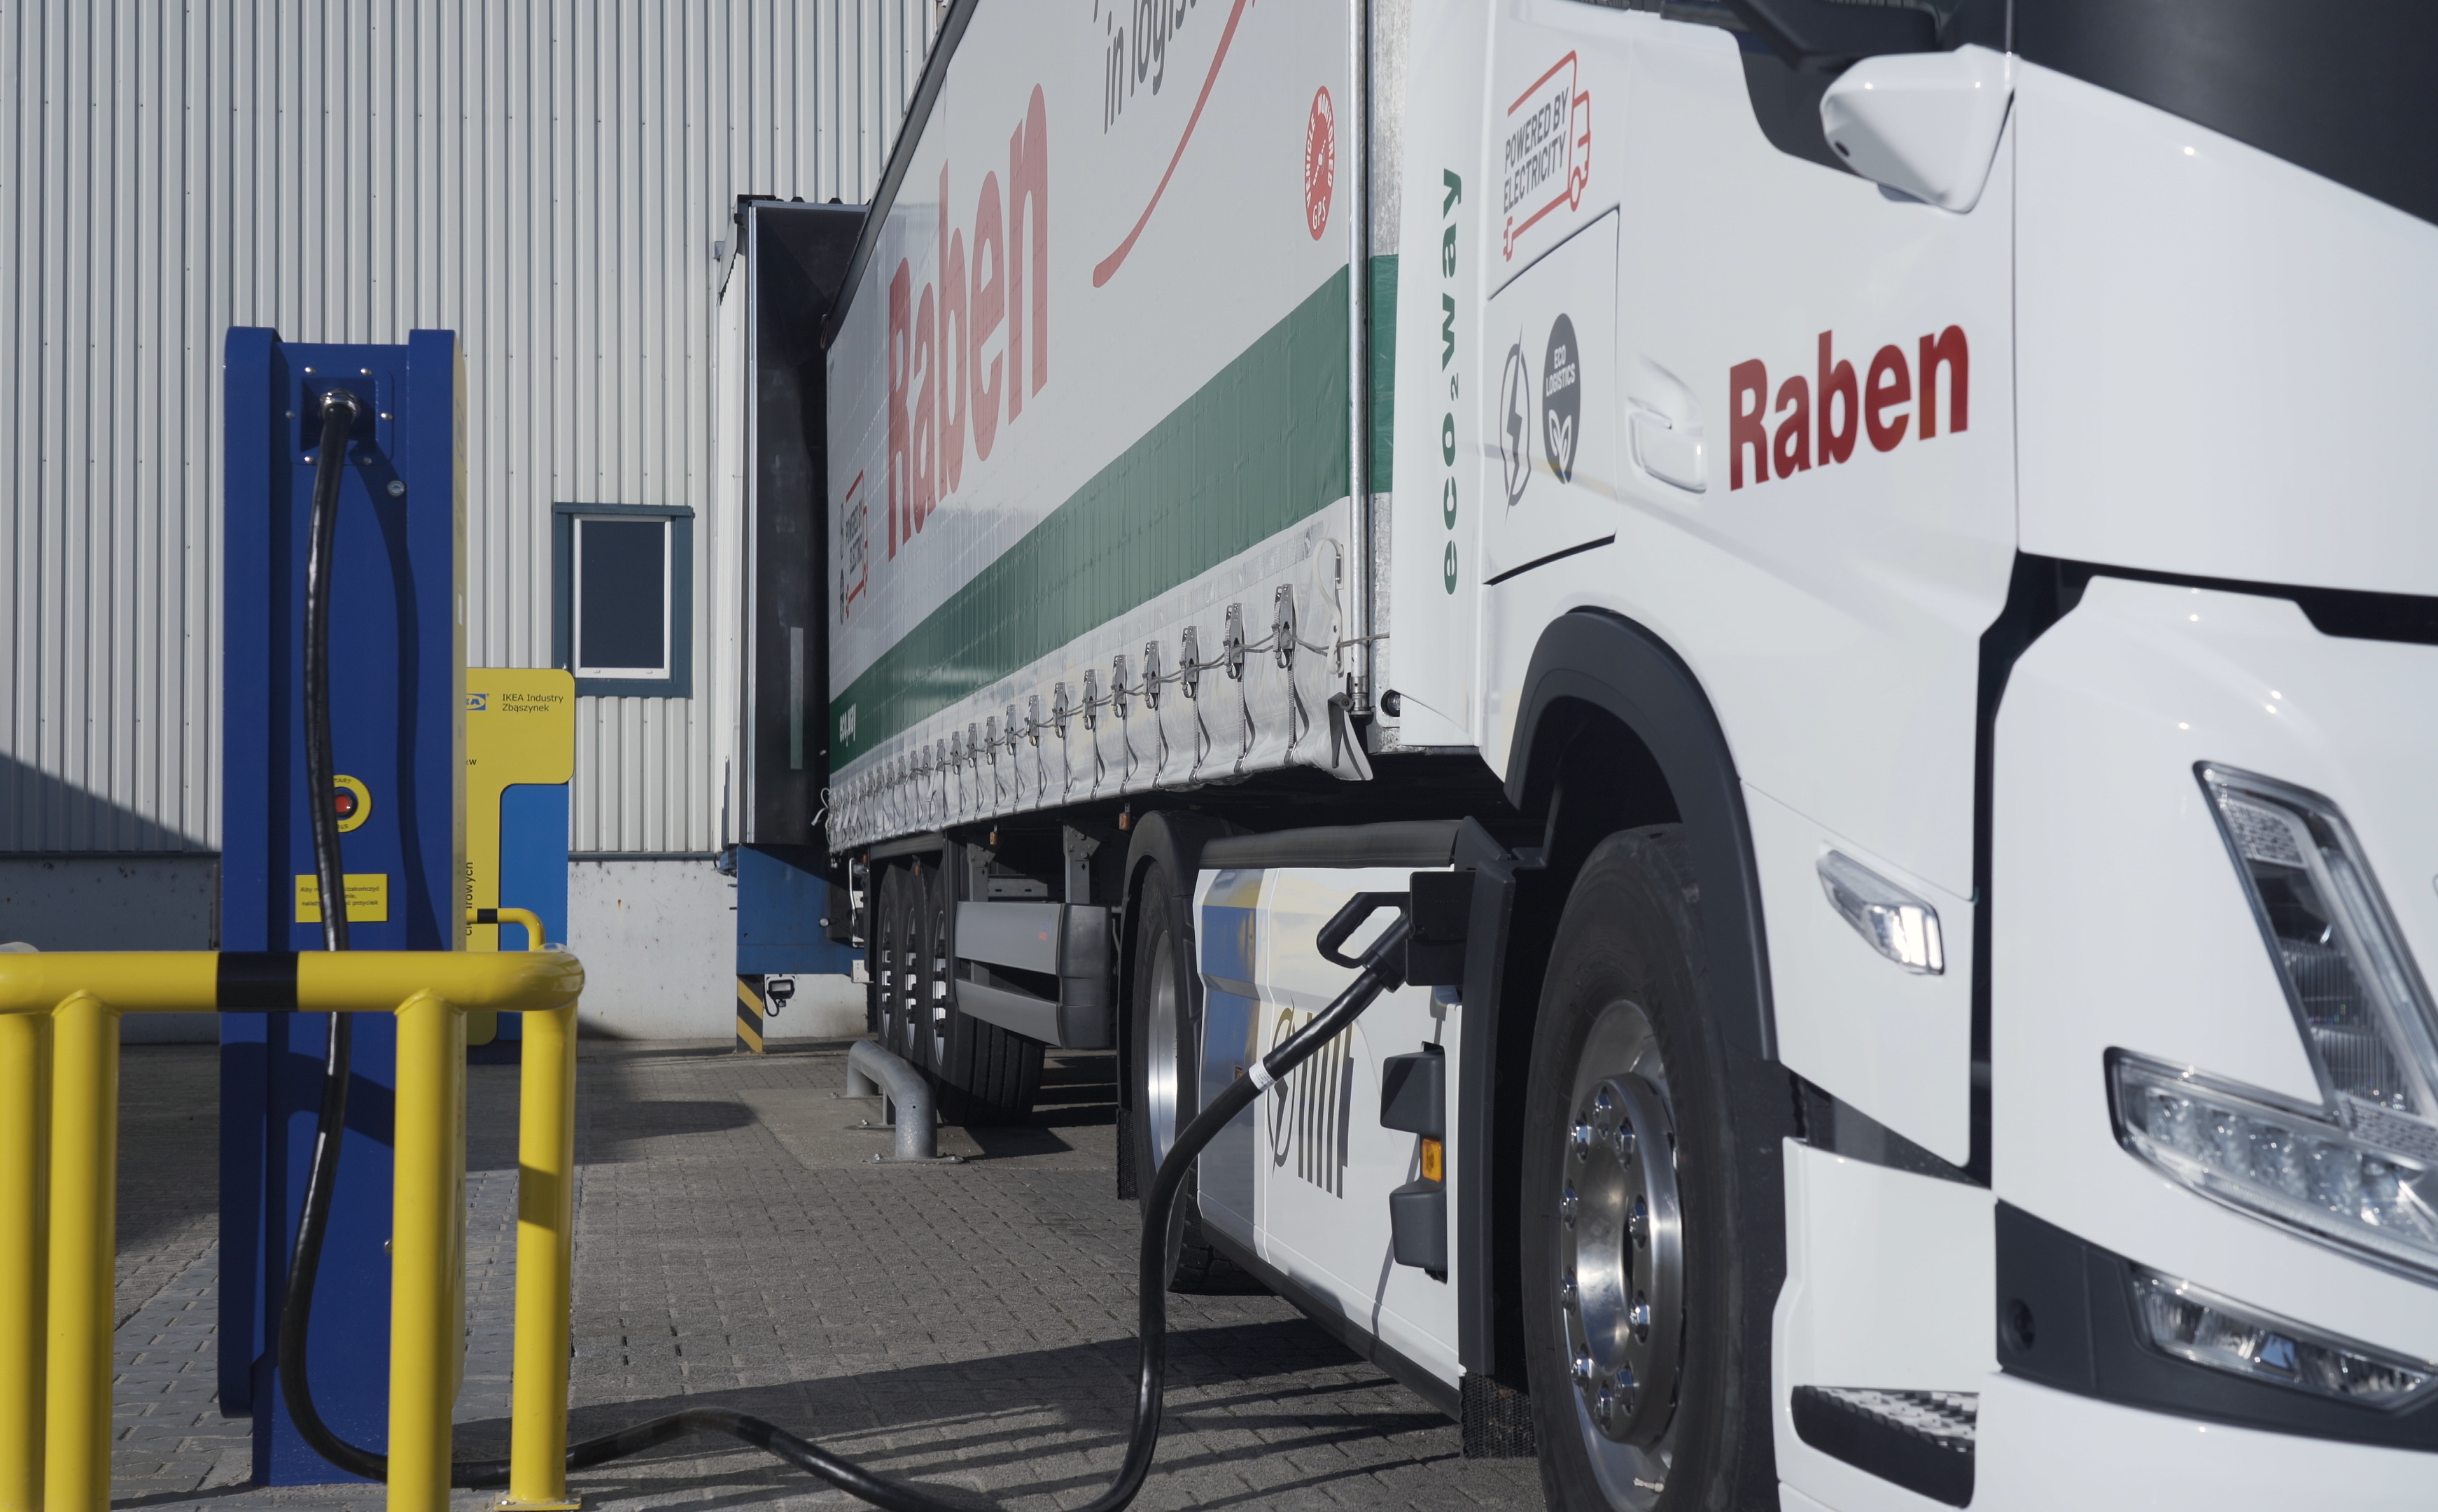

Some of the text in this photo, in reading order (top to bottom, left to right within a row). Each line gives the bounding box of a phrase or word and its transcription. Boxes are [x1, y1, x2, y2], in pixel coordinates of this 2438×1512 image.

[1104, 10, 1124, 134] in
[1305, 92, 1333, 209] VEHICLE MONITORED
[1505, 85, 1569, 174] POWERED BY
[1312, 195, 1326, 230] GPS
[1504, 130, 1567, 216] ELECTRICITY
[889, 83, 1049, 562] Raben
[1554, 344, 1567, 370] ECO
[1546, 362, 1576, 397] LOGISTICS
[1729, 324, 1969, 491] Raben
[502, 693, 564, 704] IKEA Industry
[502, 703, 549, 713] Zbąszynek
